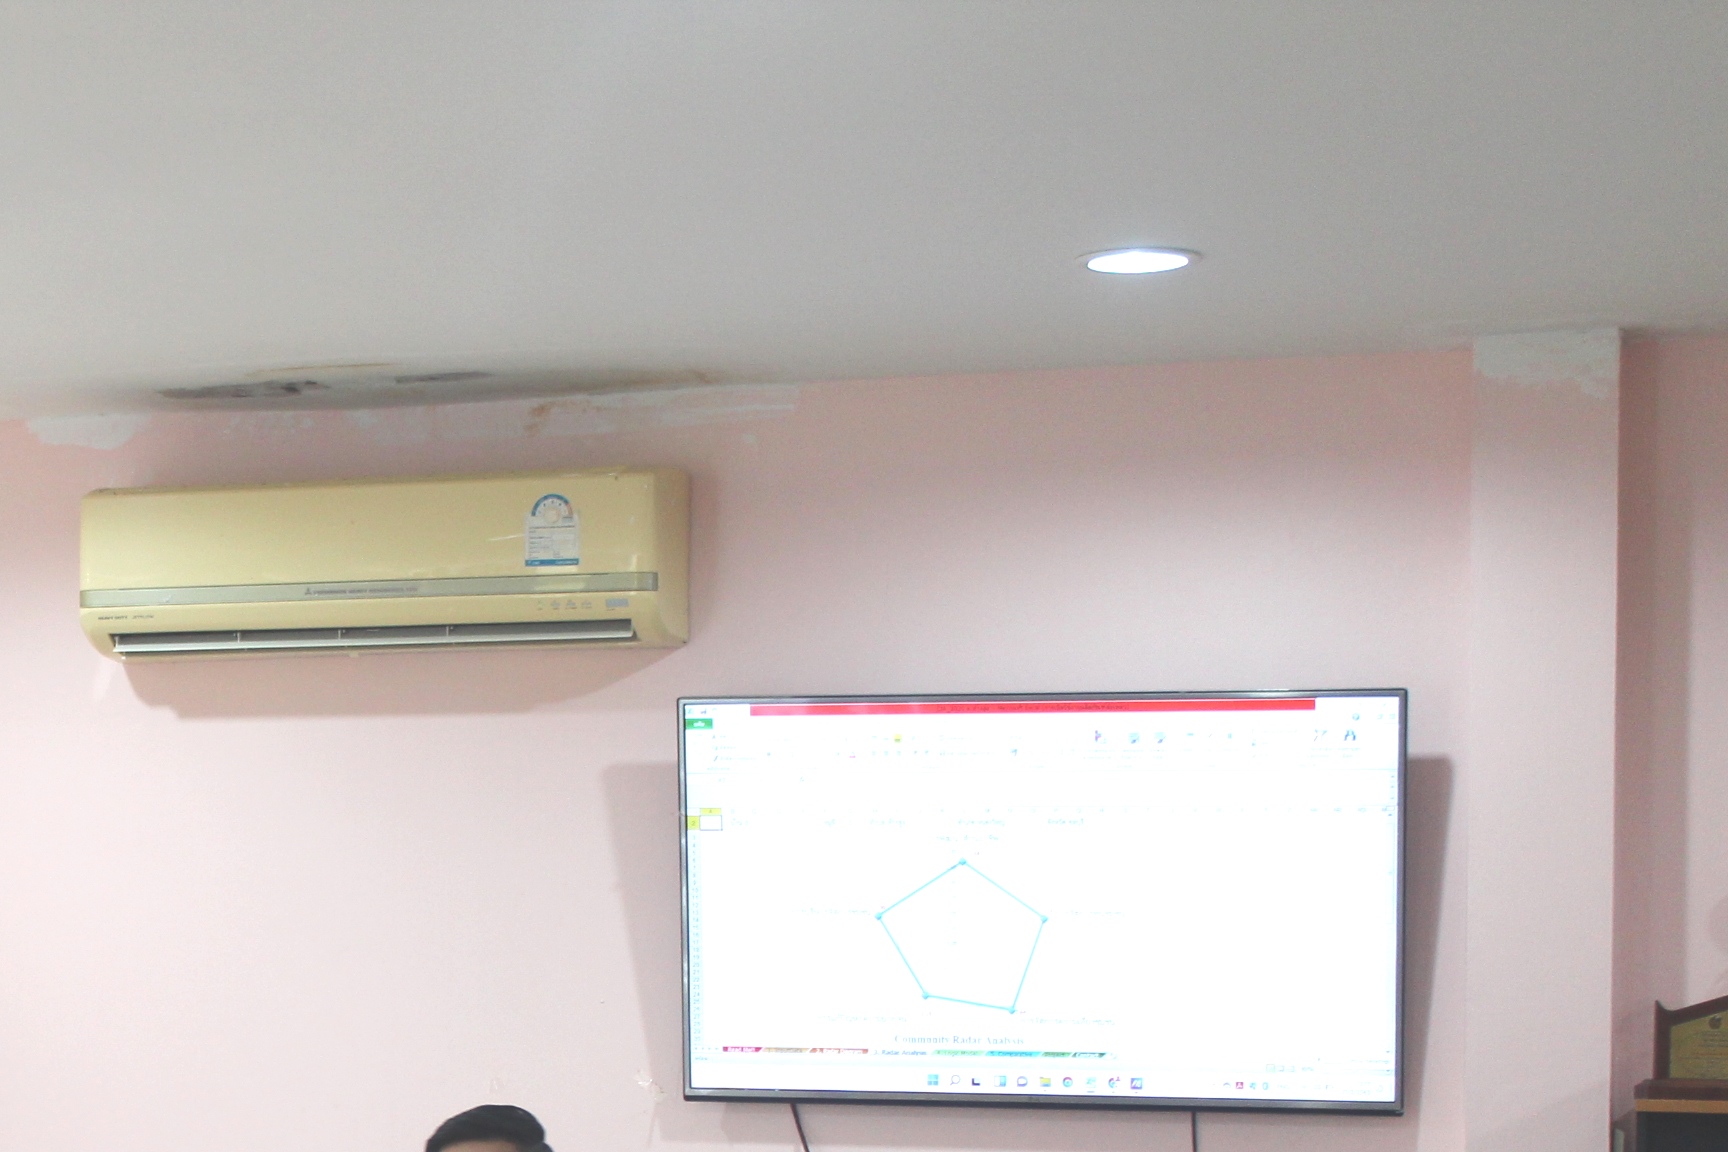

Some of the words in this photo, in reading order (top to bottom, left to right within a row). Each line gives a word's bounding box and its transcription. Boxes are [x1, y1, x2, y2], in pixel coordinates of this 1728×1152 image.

[894, 1033, 950, 1046] Community
[953, 1034, 982, 1044] Radar
[985, 1035, 1025, 1046] Analysis
